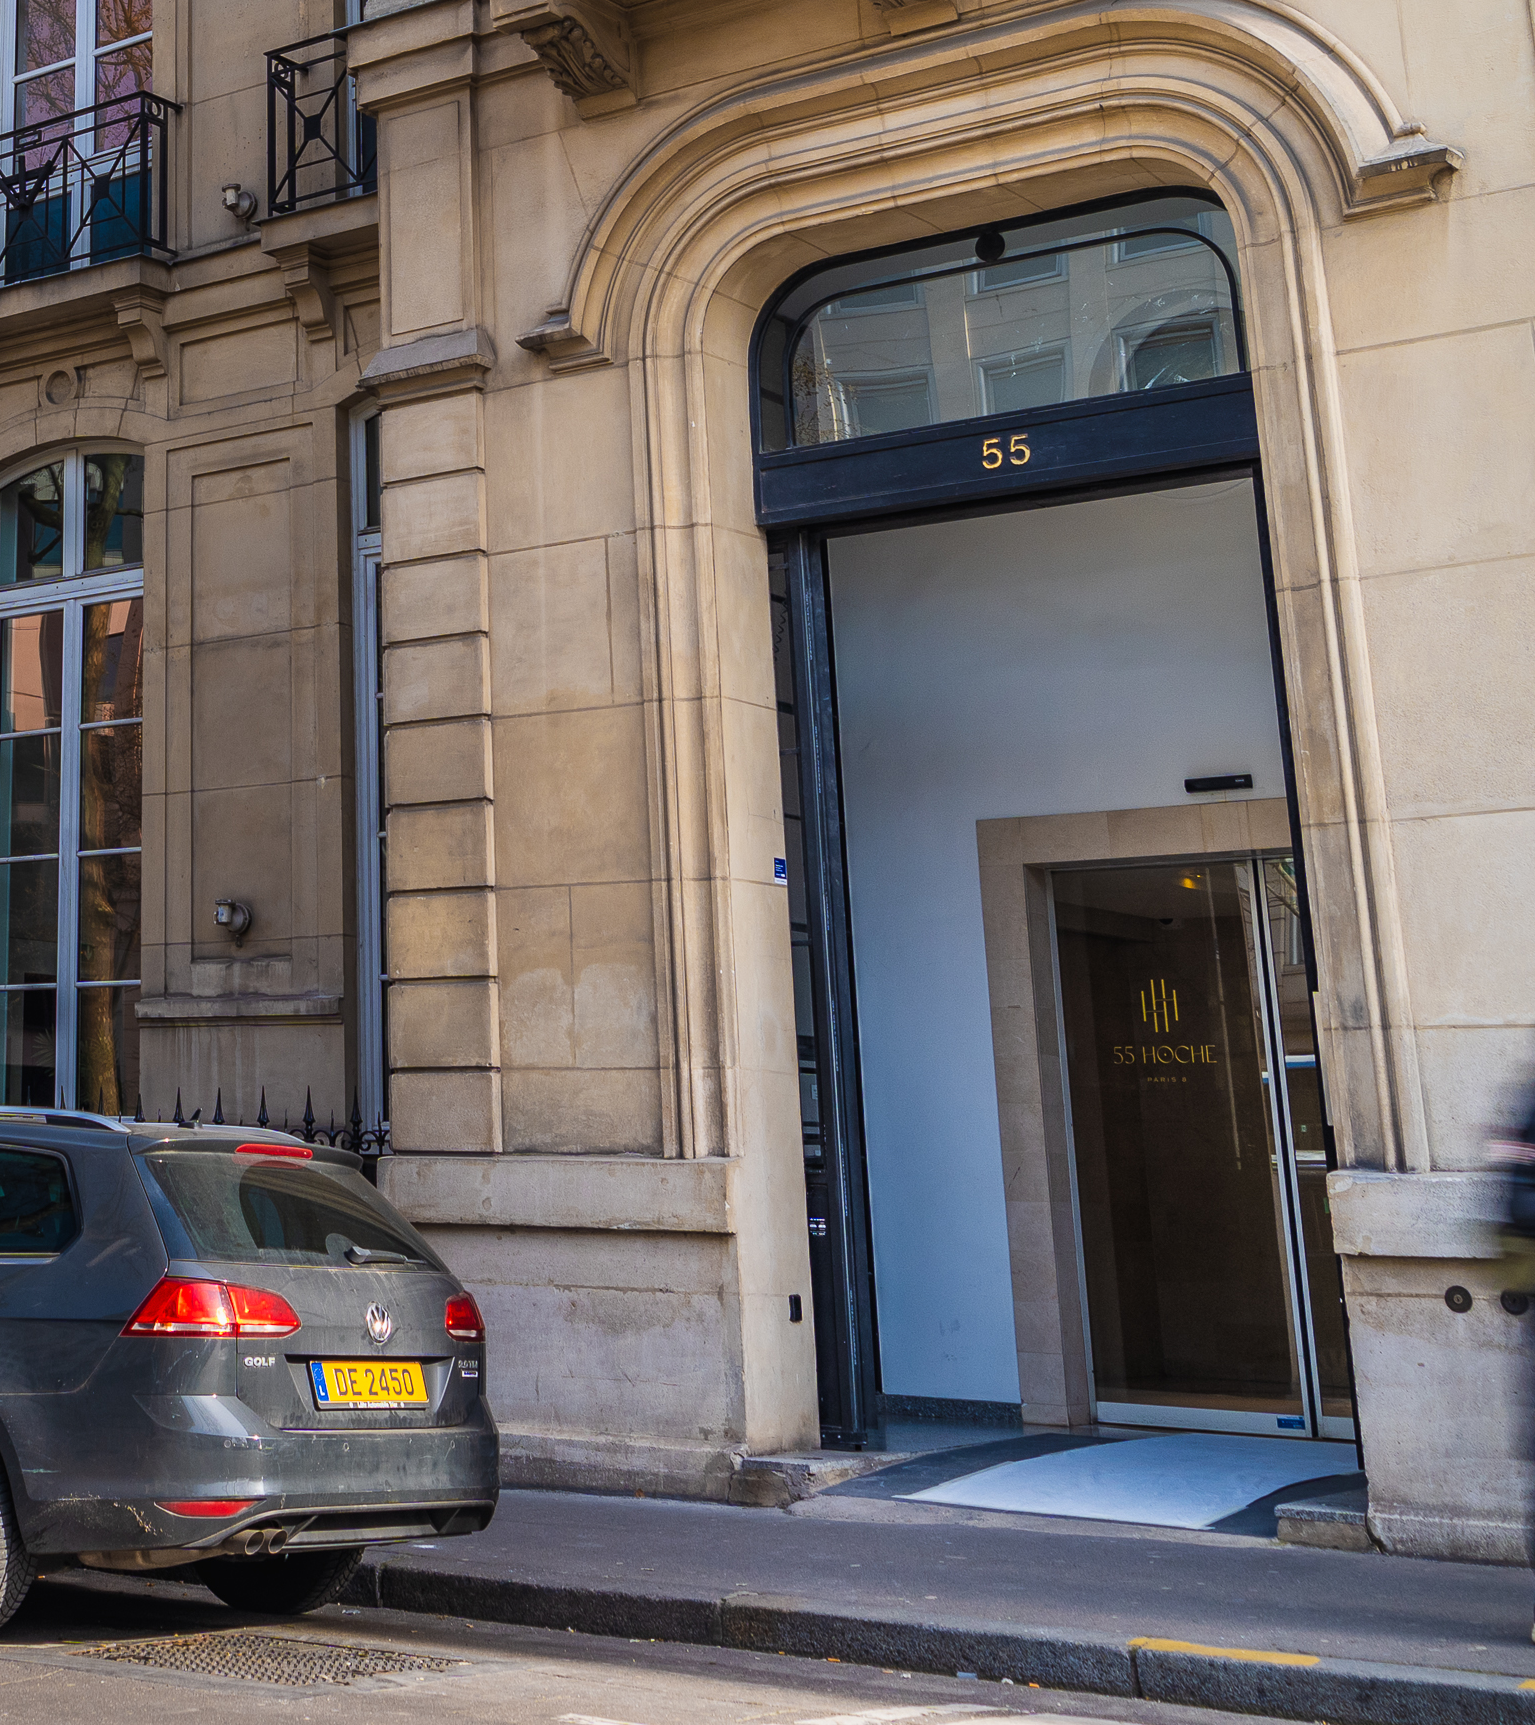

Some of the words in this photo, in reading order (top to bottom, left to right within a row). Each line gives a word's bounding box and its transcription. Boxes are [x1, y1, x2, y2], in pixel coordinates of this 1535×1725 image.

[982, 433, 1031, 470] 55
[1113, 1046, 1135, 1064] 55
[1142, 1044, 1217, 1064] HOCHE
[244, 1357, 275, 1368] GOLF
[333, 1368, 363, 1396] DE
[364, 1368, 415, 1396] 2450
